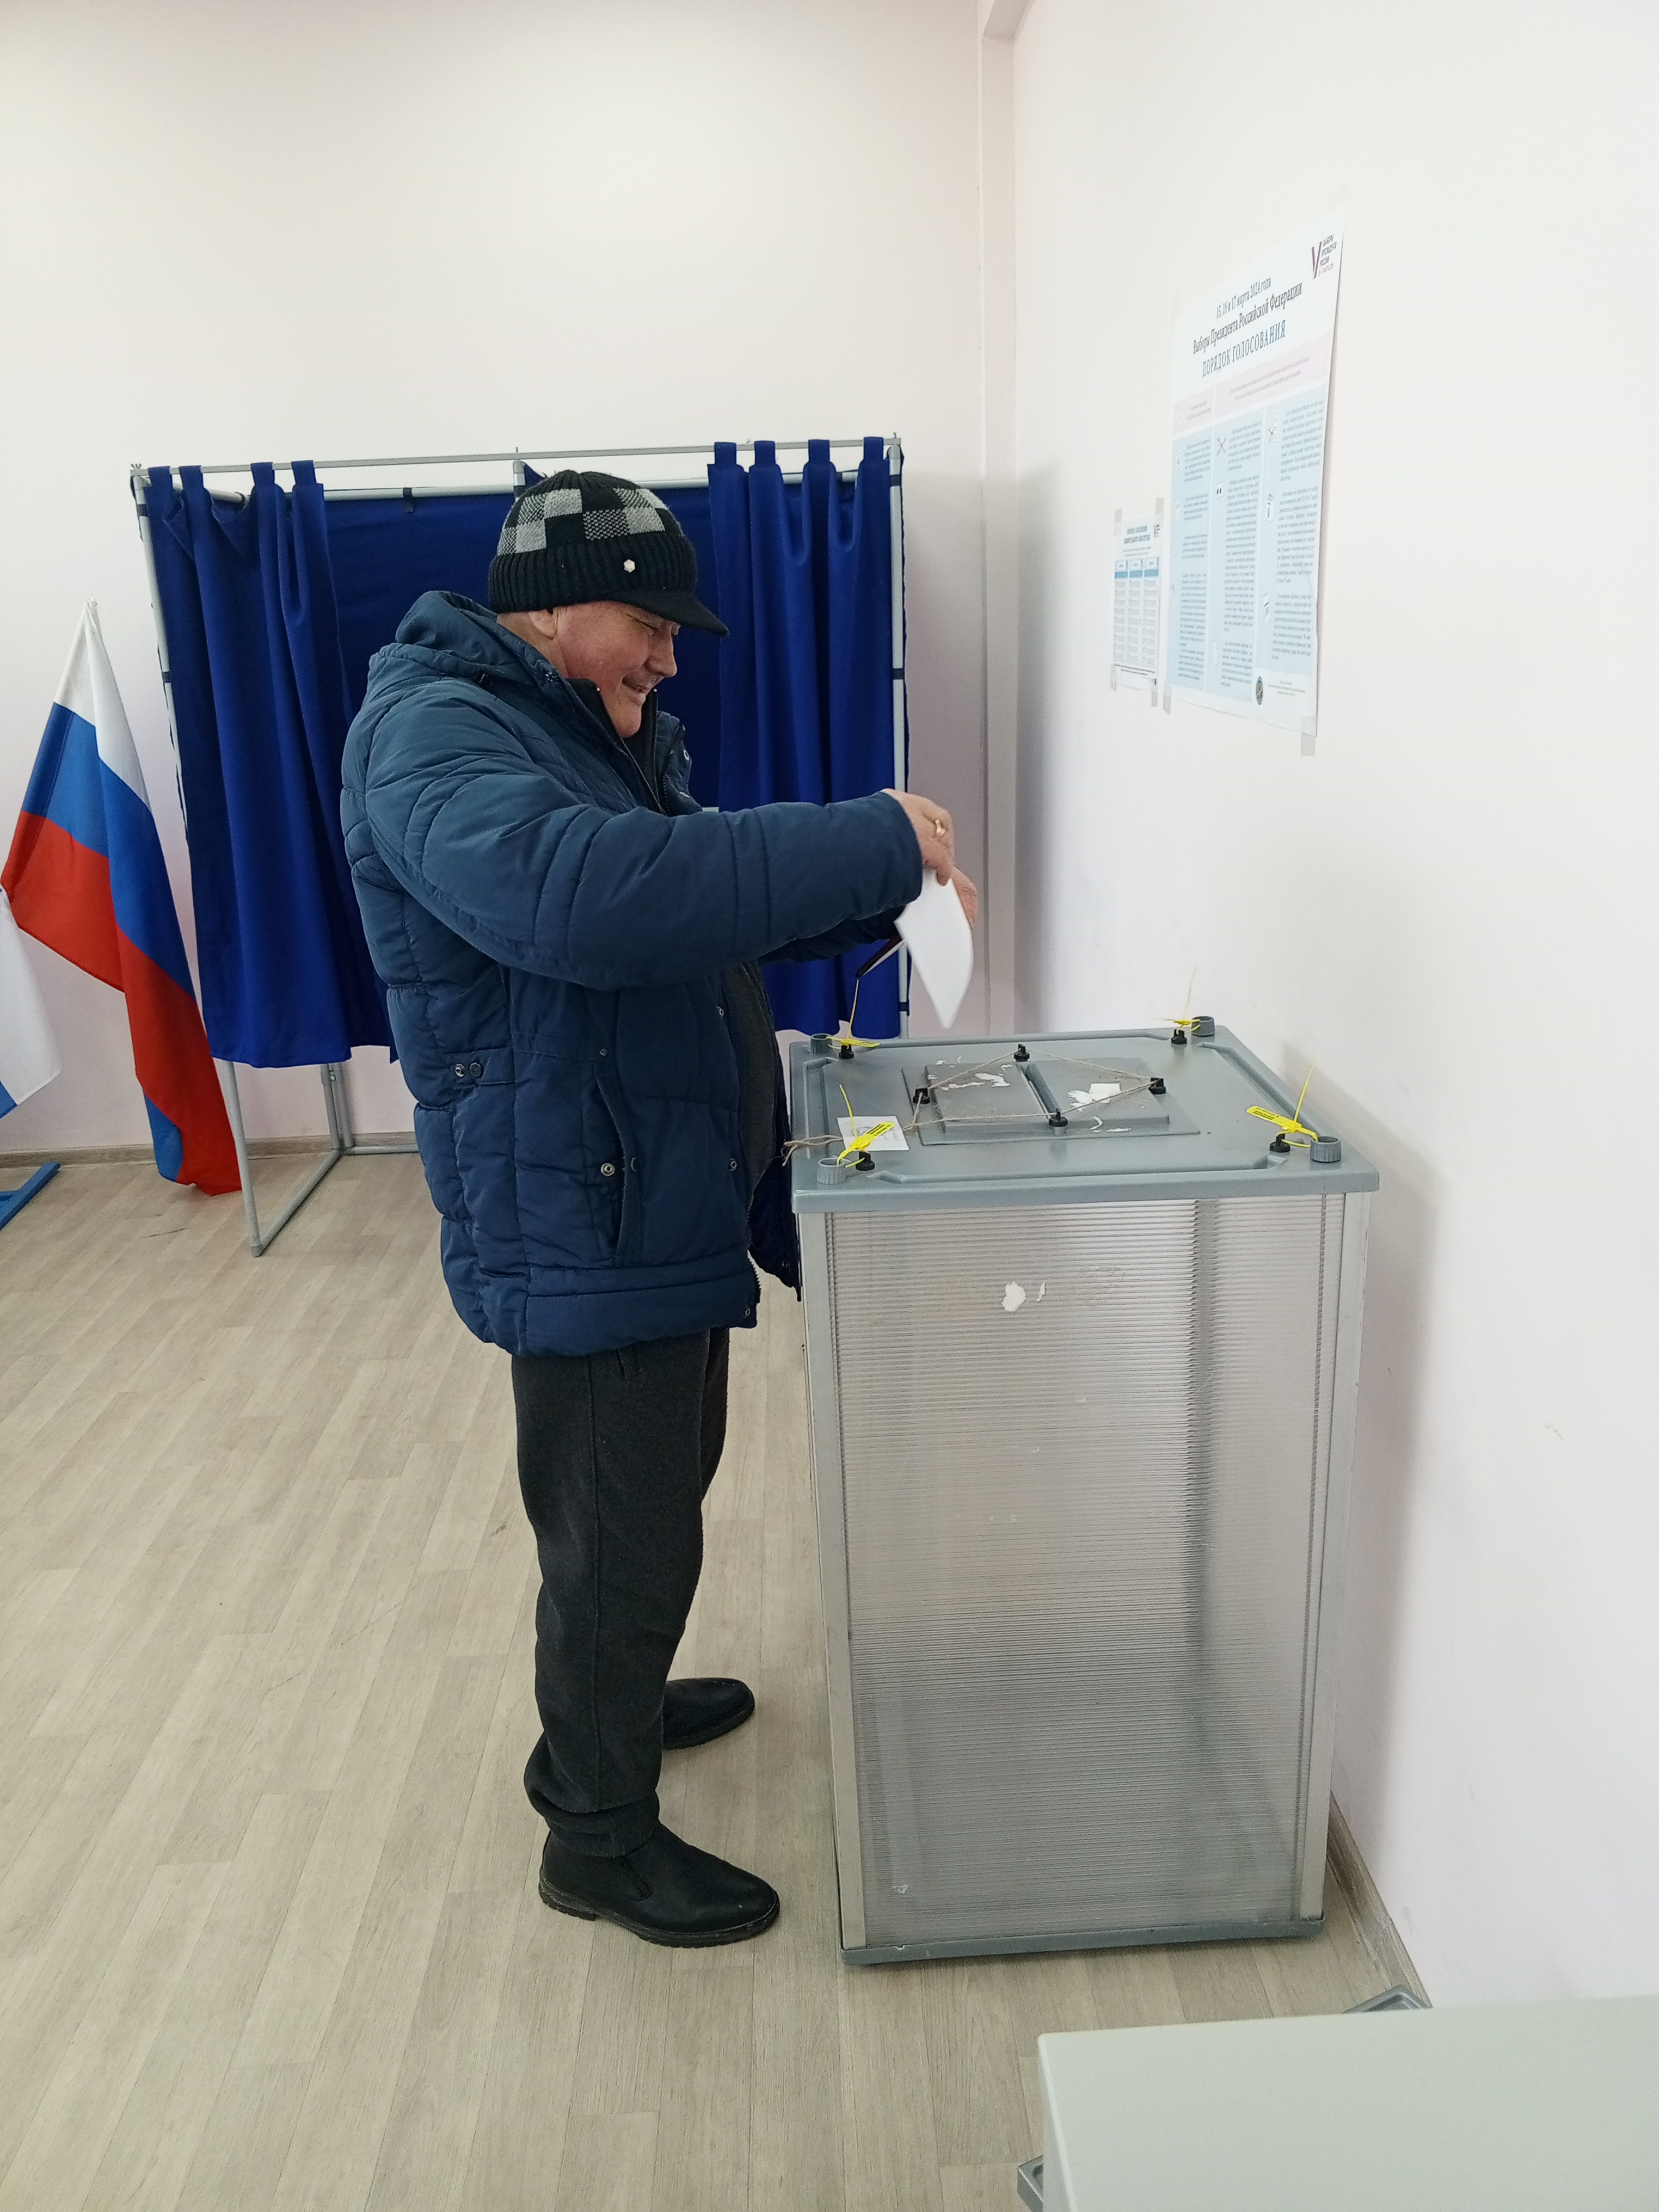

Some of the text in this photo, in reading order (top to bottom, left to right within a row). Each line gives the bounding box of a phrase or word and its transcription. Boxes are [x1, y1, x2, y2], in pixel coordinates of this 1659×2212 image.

[1193, 282, 1302, 354] Выборы Президента Российской Федерации
[1232, 295, 1237, 310] 17
[1237, 291, 1250, 308] марта
[1250, 280, 1261, 299] 2024
[1261, 277, 1271, 293] года
[1202, 348, 1231, 378] ПОРЯДОК
[1232, 319, 1286, 362] ГОЛОСОВАНИЯ
